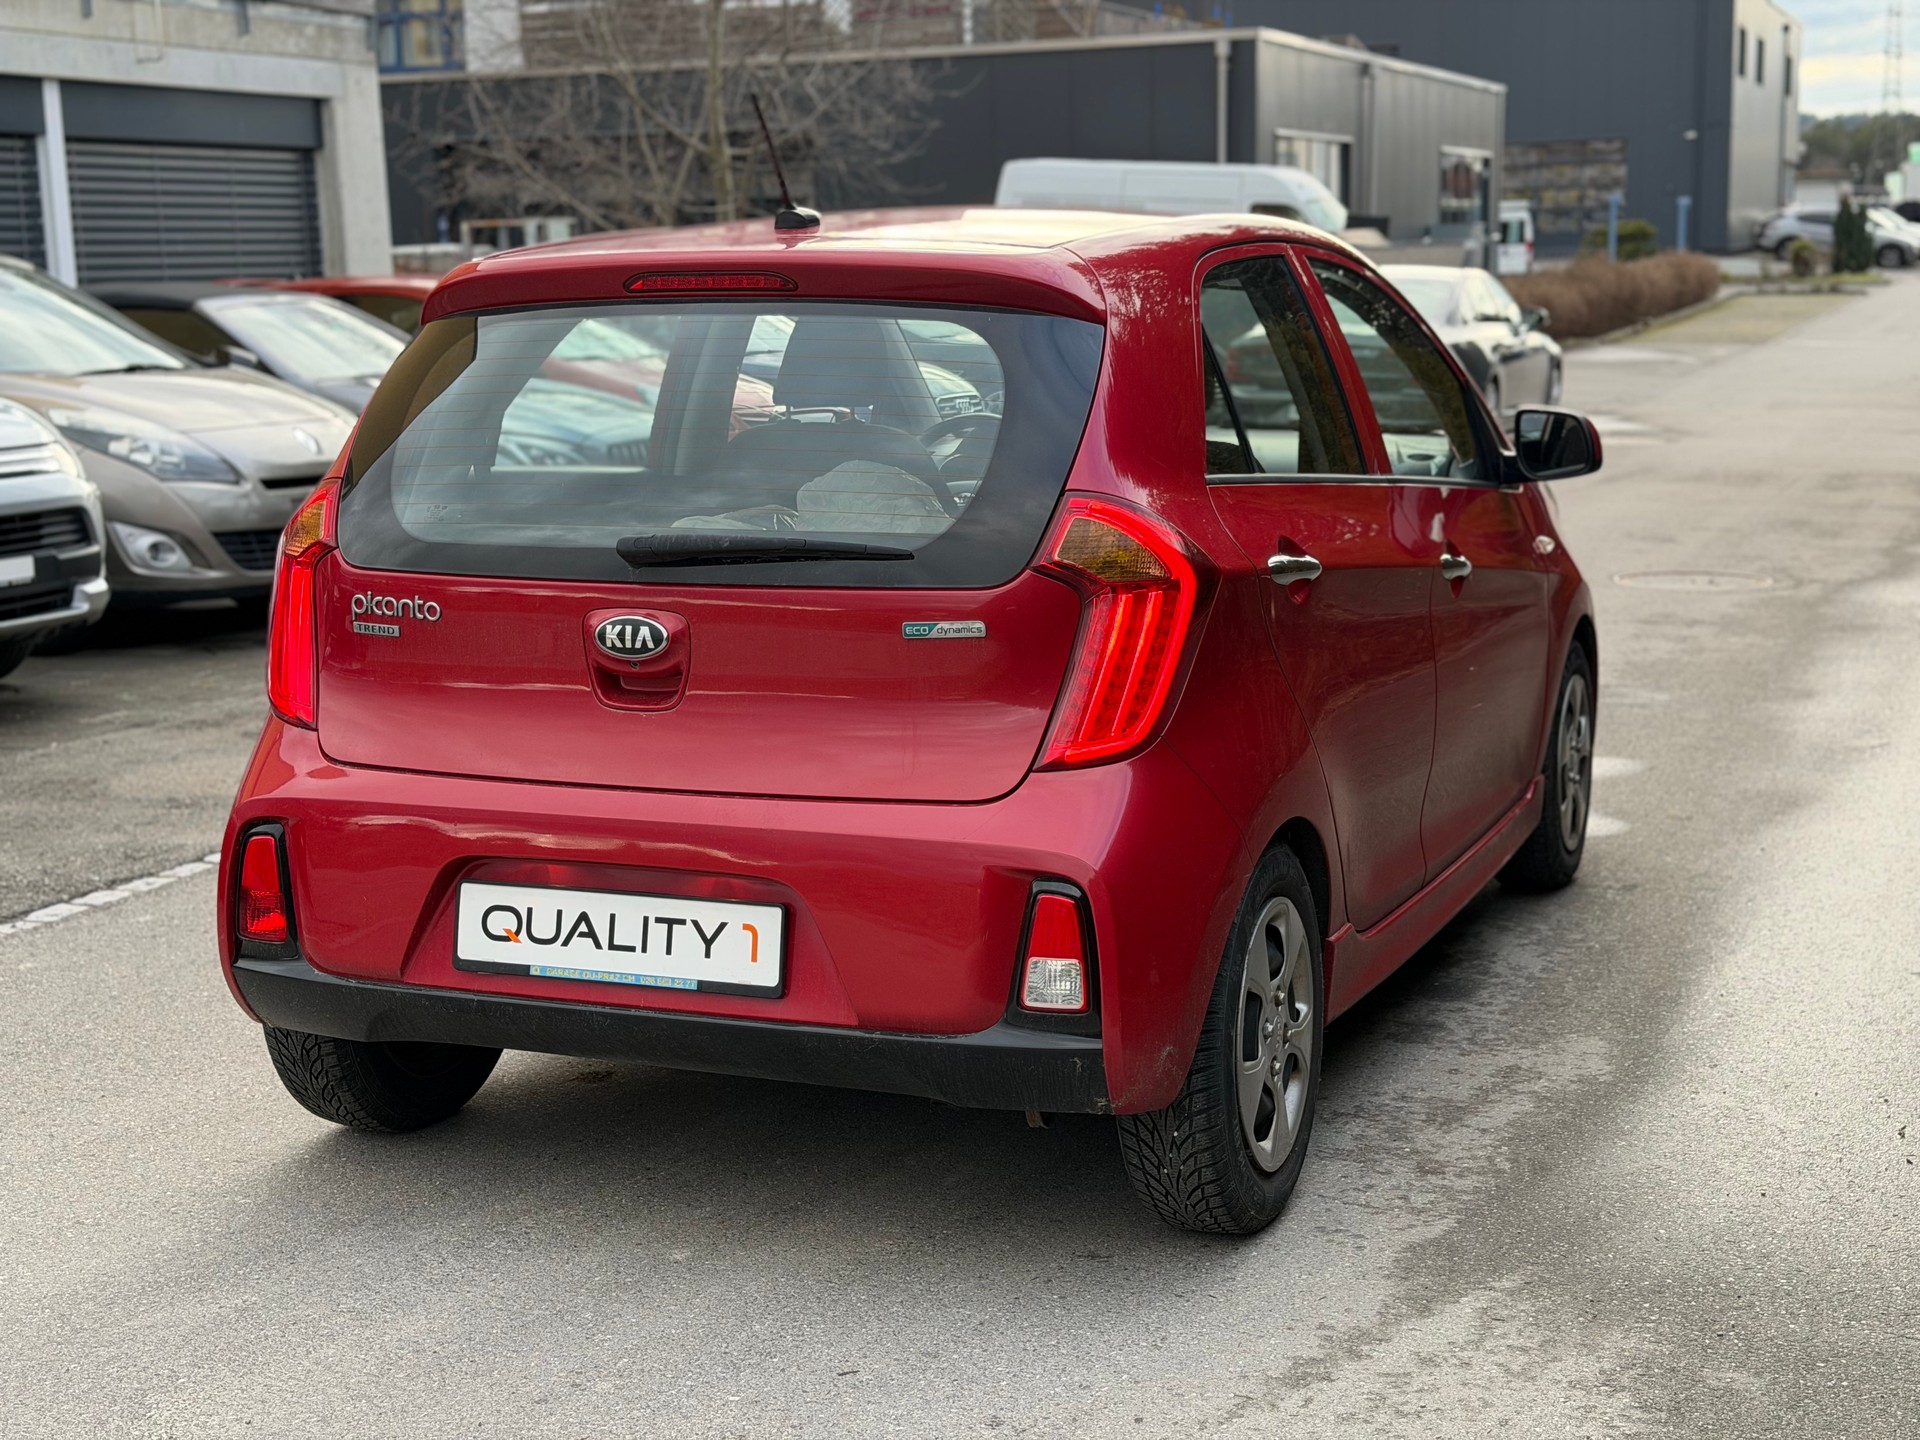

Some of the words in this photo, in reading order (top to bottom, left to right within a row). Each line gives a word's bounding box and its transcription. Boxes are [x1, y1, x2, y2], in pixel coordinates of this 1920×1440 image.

[351, 591, 441, 621] picanto
[357, 623, 395, 635] TREND
[605, 624, 655, 649] KIA
[905, 626, 929, 635] ECO
[936, 626, 983, 636] dynamics
[481, 904, 729, 959] QUALITY
